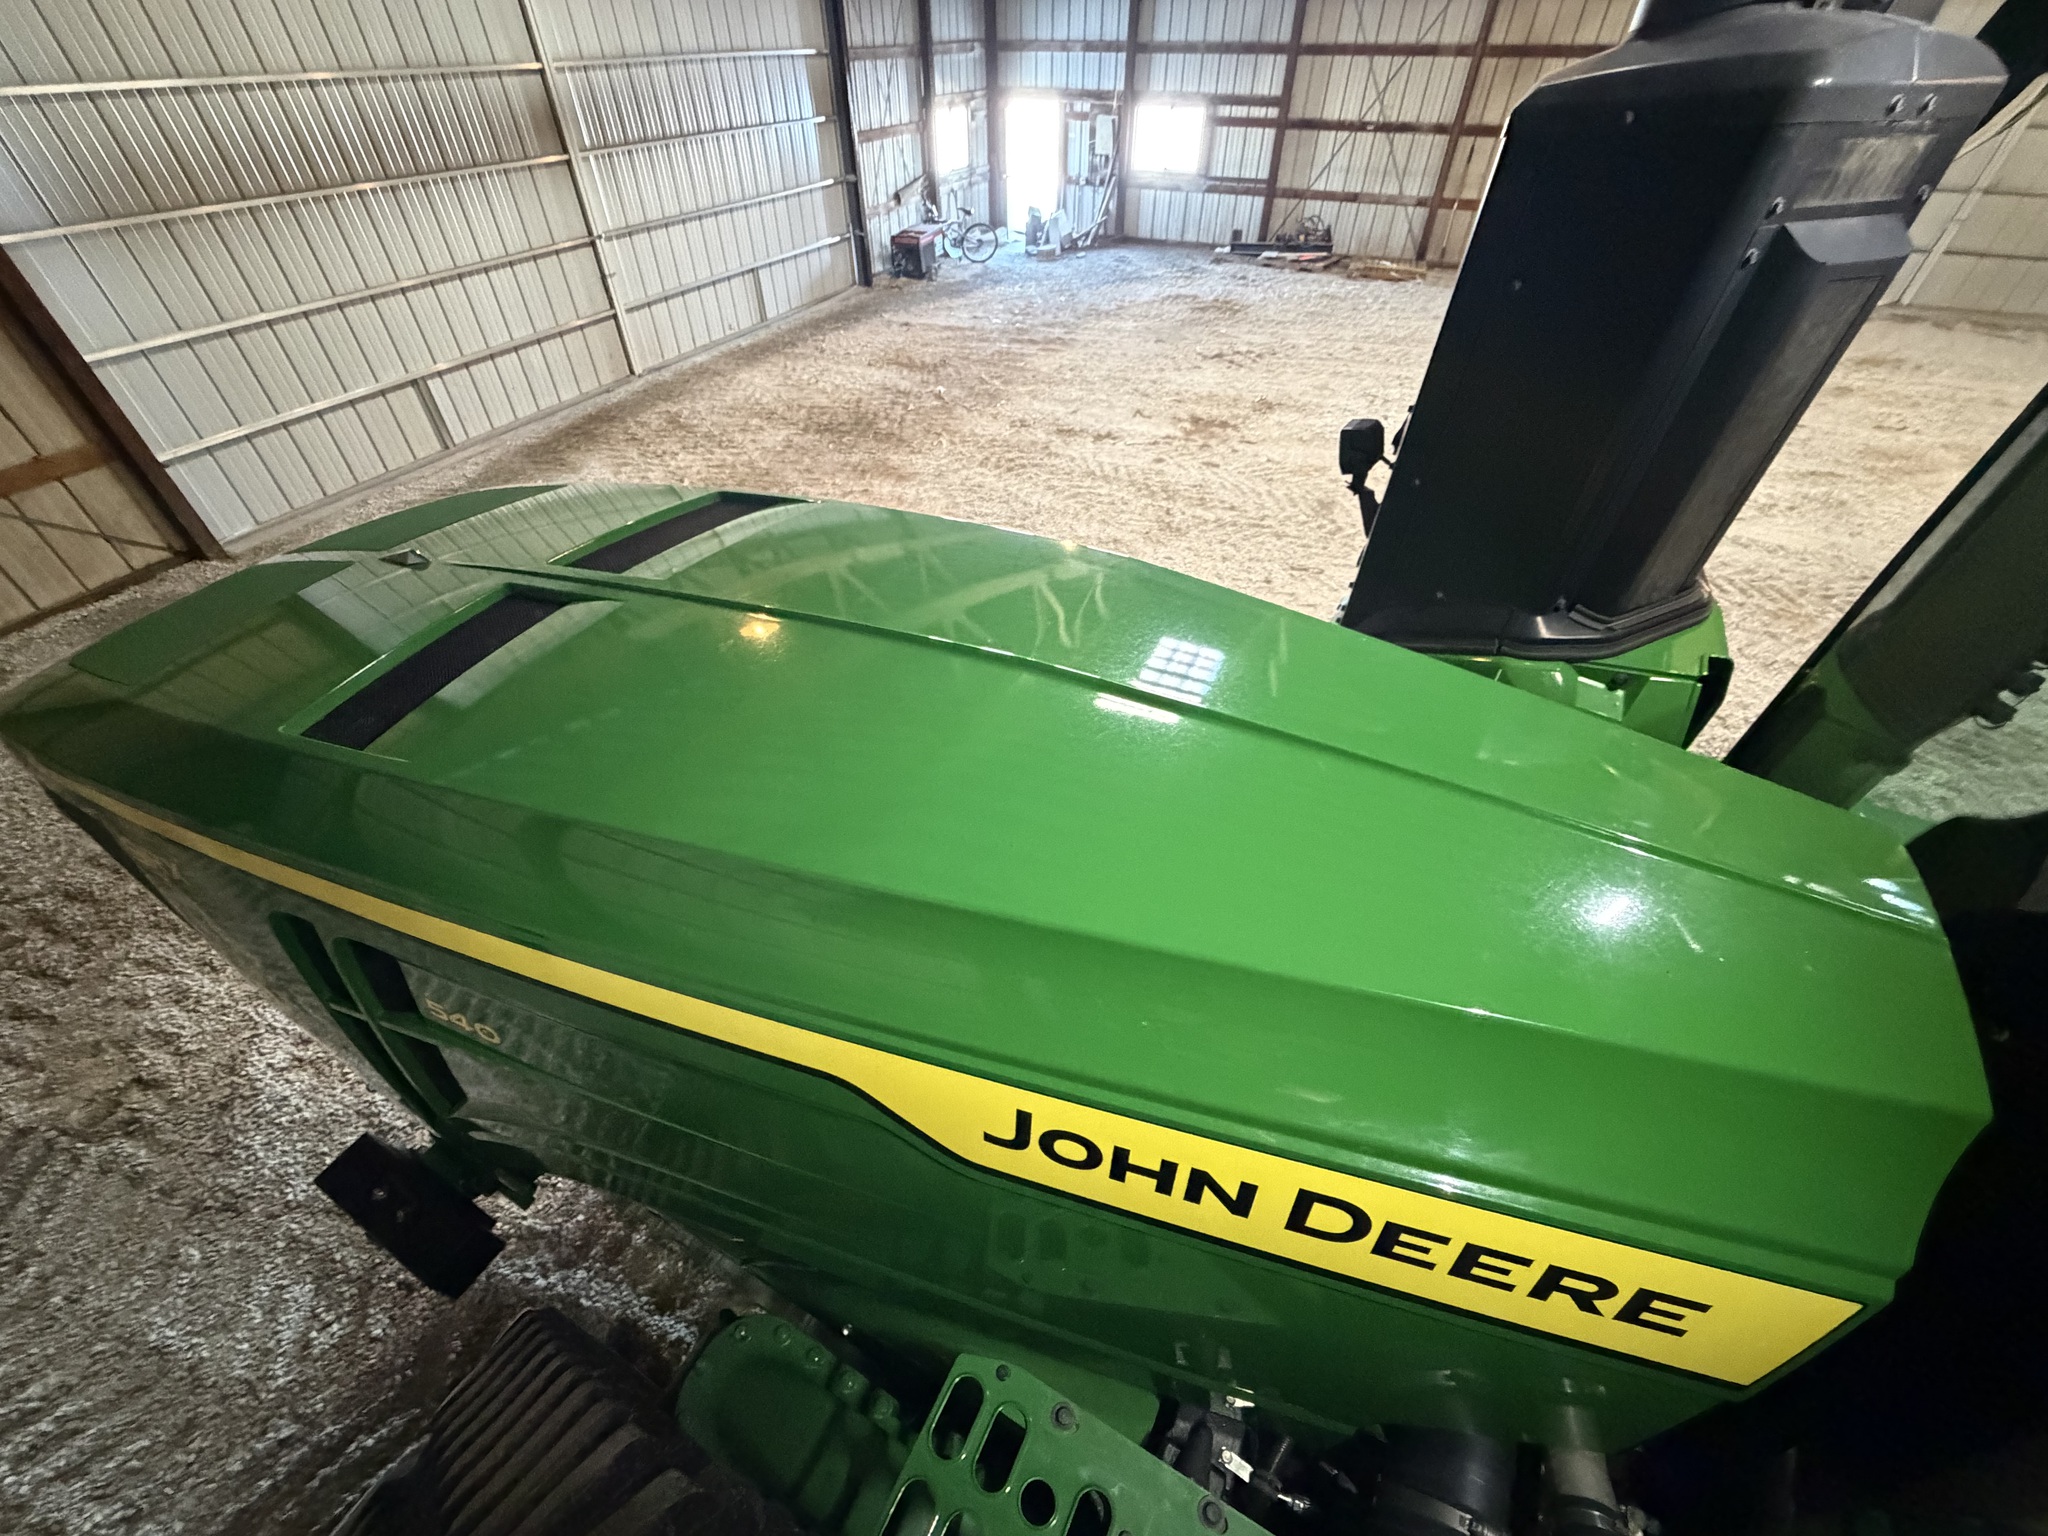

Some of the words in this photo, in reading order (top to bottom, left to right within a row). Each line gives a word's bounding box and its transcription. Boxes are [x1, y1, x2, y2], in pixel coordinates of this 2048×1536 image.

[424, 994, 501, 1044] 540
[983, 1109, 1258, 1219] JOHN
[1284, 1187, 1713, 1338] DEERE
